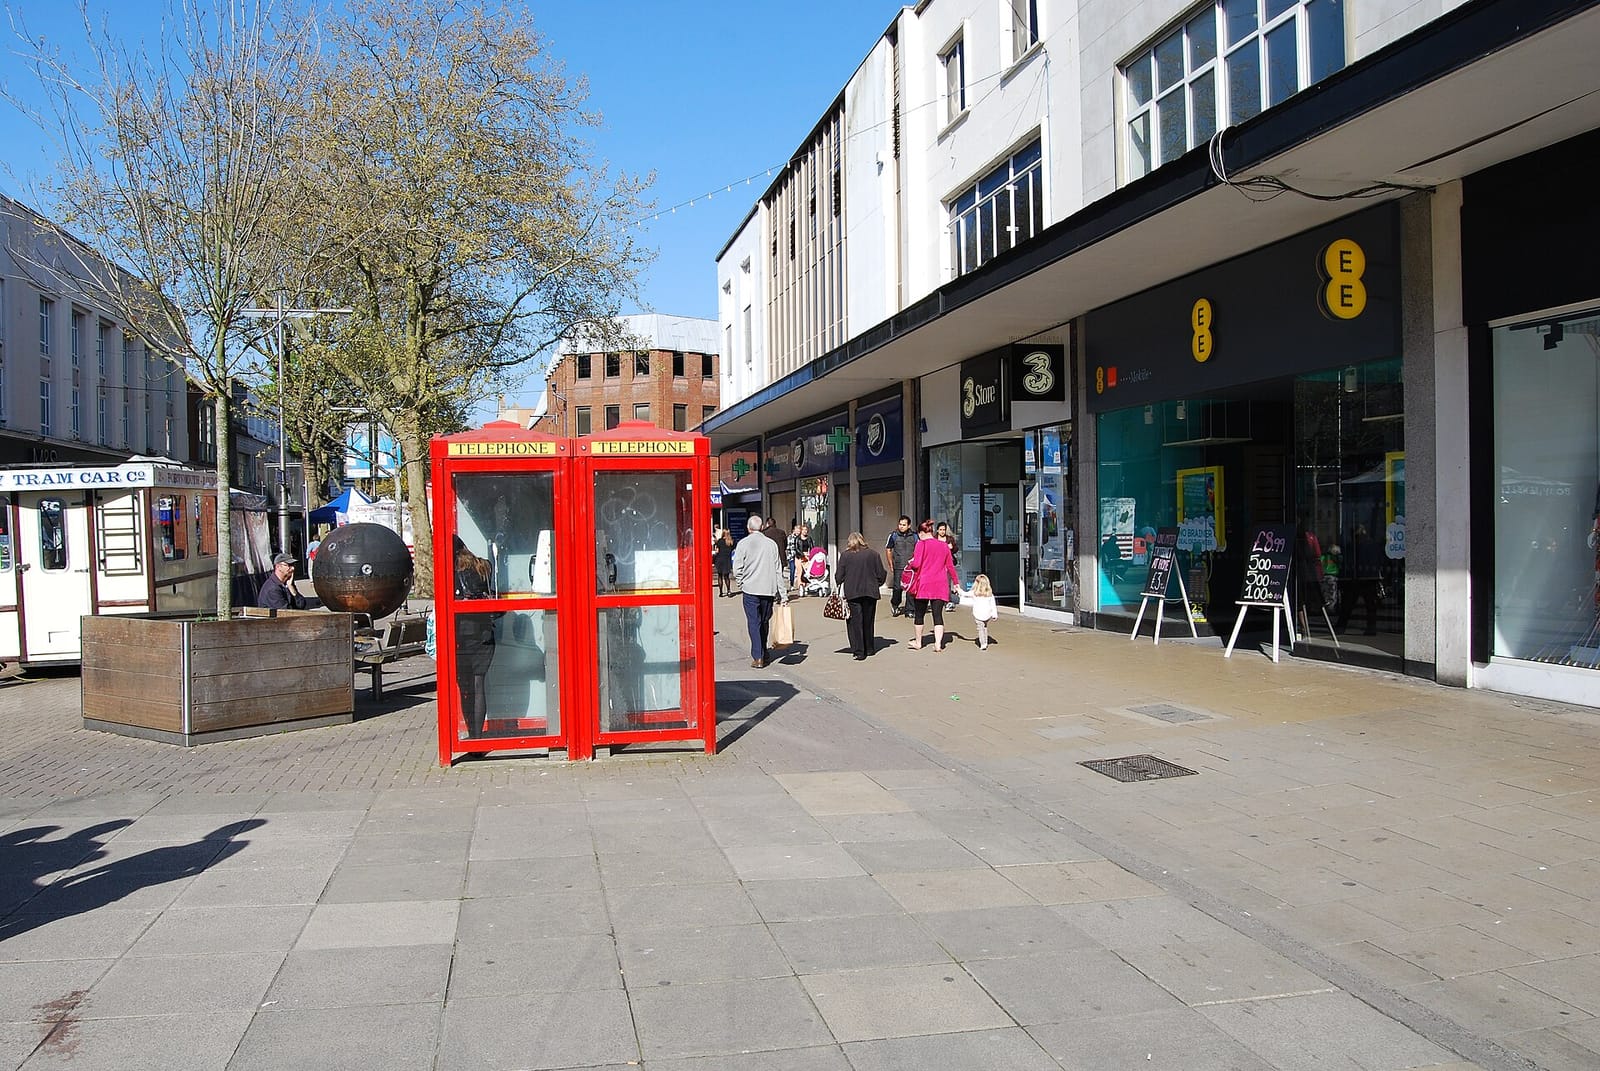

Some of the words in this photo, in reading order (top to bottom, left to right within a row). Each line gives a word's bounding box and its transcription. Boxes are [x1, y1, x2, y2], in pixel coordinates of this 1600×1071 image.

[975, 384, 996, 407] Store
[456, 443, 549, 455] TELEPHONE
[598, 441, 688, 453] TELEPHONE
[13, 473, 73, 486] TRAM
[80, 471, 121, 483] CAR
[1252, 531, 1286, 553] £8.99
[1248, 554, 1271, 570] 500
[1245, 570, 1270, 586] 500
